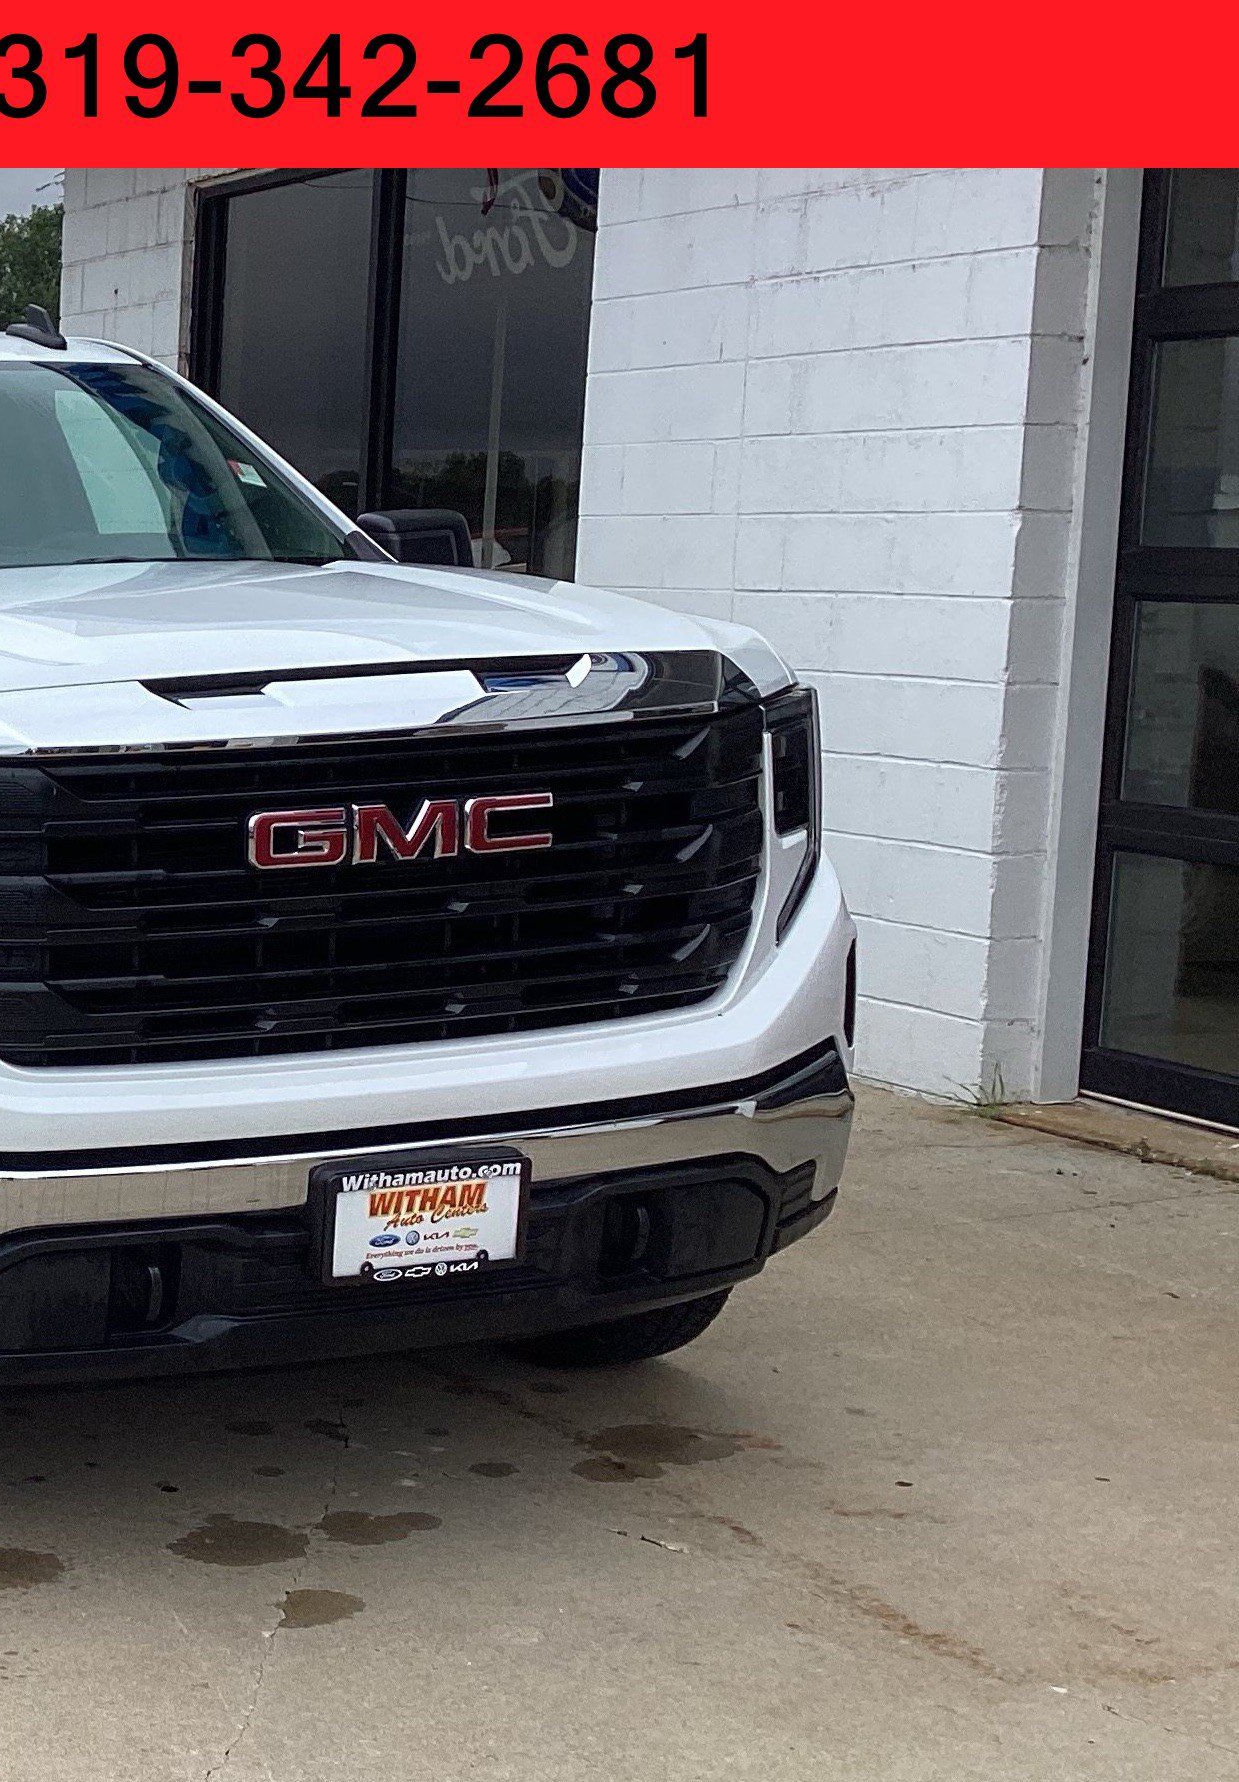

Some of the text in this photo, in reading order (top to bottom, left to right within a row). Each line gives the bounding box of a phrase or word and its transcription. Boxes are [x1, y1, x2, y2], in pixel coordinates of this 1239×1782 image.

[249, 793, 553, 869] GMC
[342, 1163, 521, 1192] Withamauto.com
[369, 1181, 487, 1217] WITHAM
[384, 1211, 424, 1231] Auto
